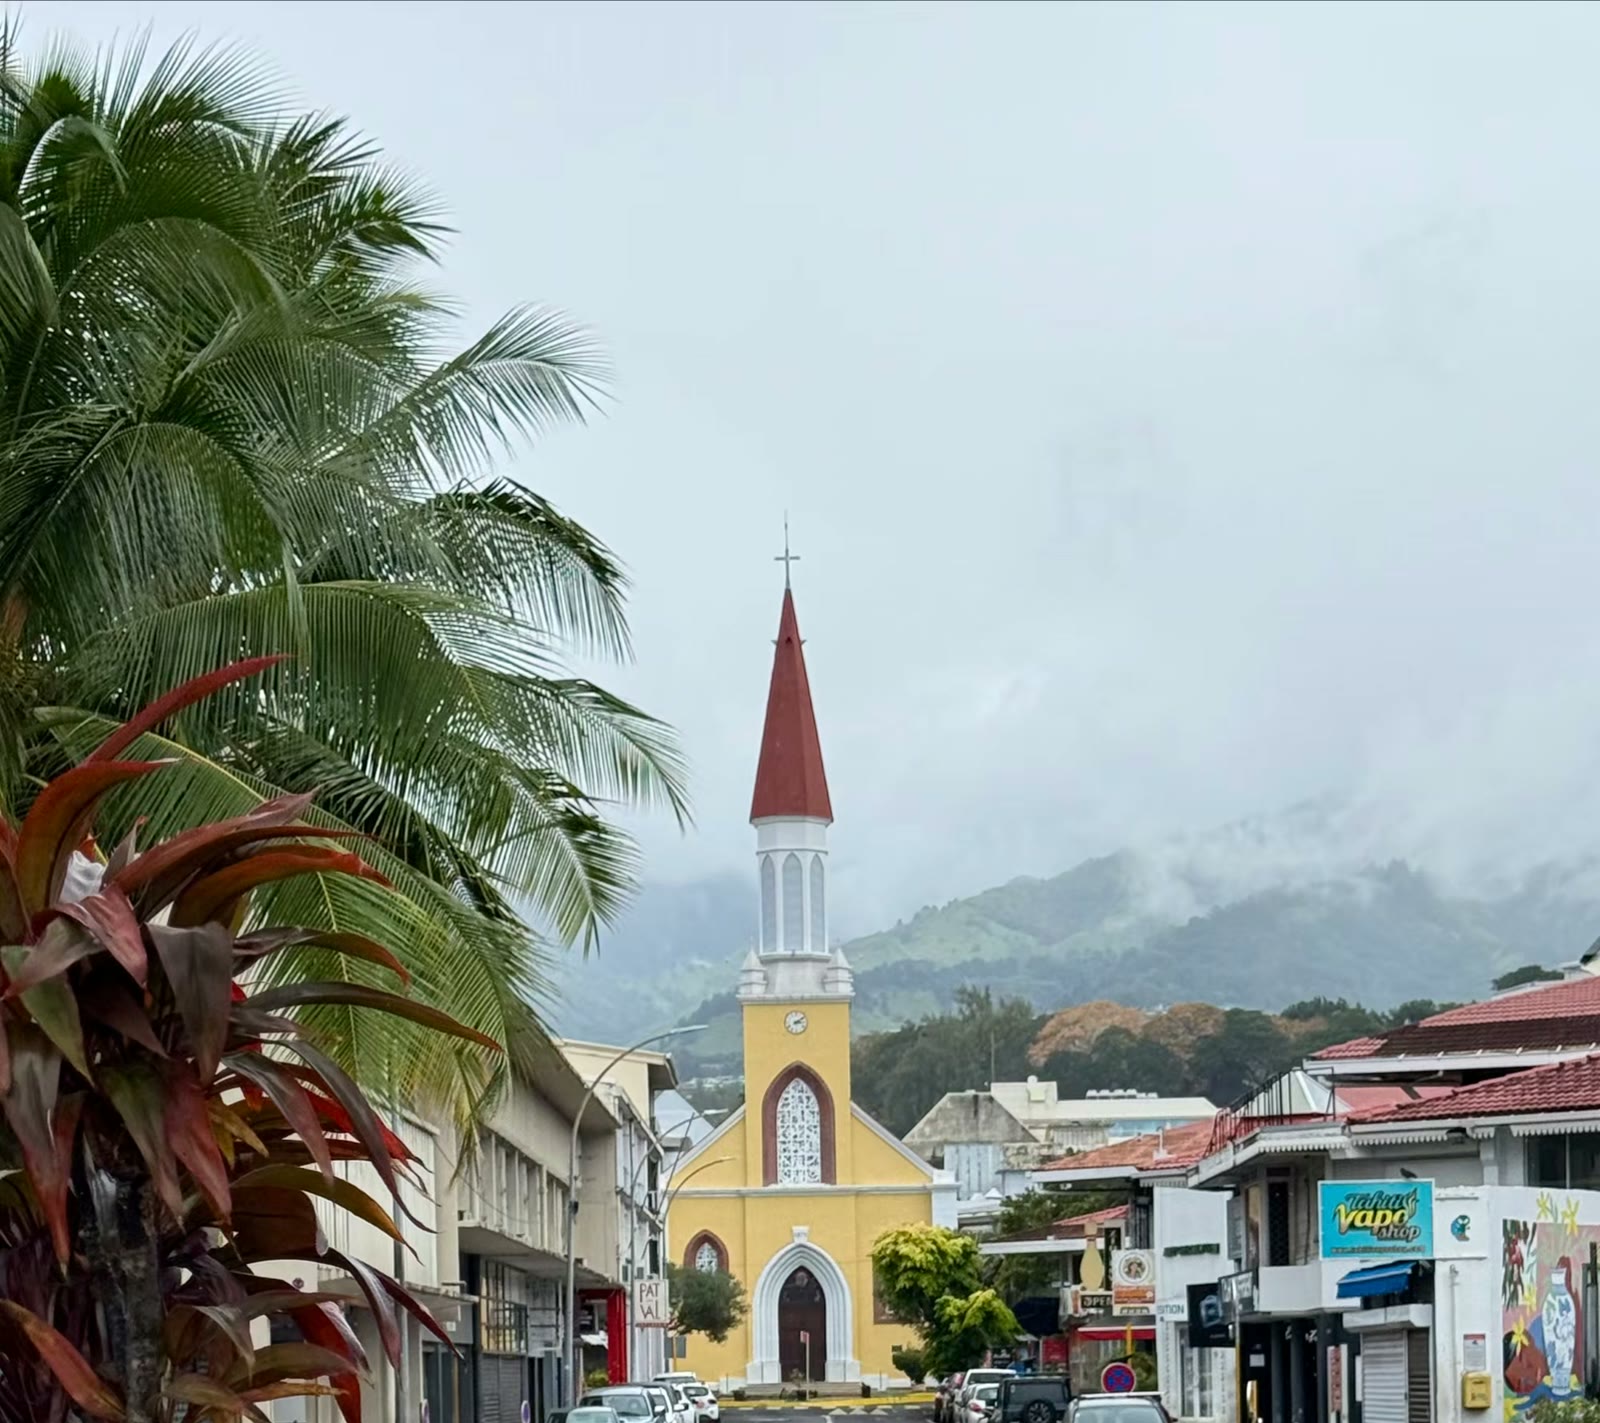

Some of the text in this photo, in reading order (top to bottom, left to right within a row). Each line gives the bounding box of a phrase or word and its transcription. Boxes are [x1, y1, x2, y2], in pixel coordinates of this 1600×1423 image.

[1345, 1190, 1407, 1210] Tahiti
[1377, 1225, 1420, 1242] shop
[640, 1283, 660, 1303] PAT
[640, 1300, 661, 1320] VAL
